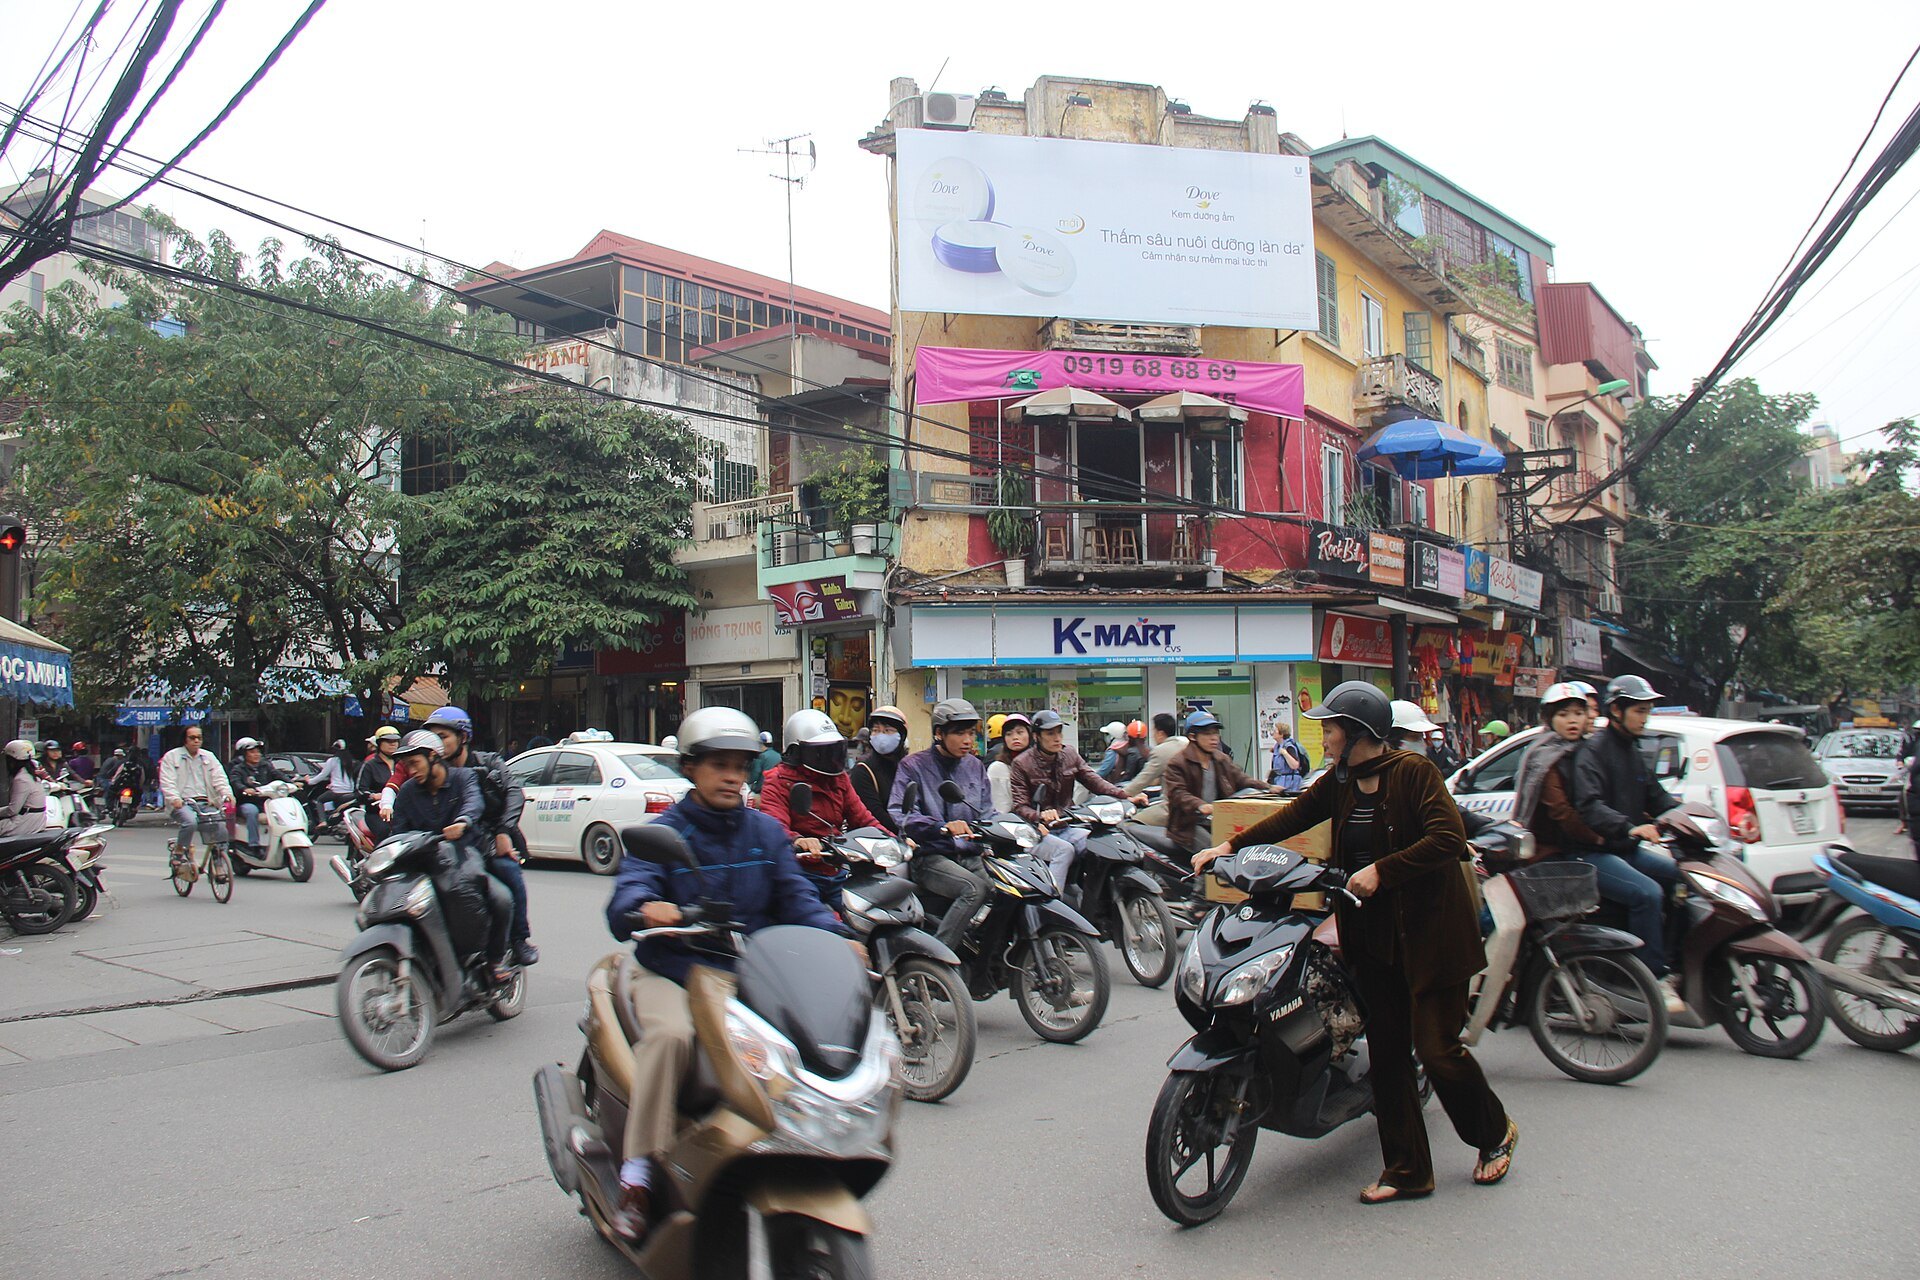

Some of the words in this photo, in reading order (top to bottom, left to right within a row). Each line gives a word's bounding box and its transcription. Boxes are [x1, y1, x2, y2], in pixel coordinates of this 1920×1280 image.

[932, 180, 960, 195] Dove
[1185, 185, 1221, 200] Dove
[1171, 209, 1191, 219] Kem
[1022, 239, 1055, 257] Dove
[1101, 227, 1142, 245] Thấm
[1146, 232, 1172, 247] sâu
[1177, 234, 1207, 249] nuôi
[1211, 236, 1254, 255] dưỡng
[1259, 239, 1279, 254] làn
[1142, 250, 1163, 261] Cảm
[1063, 355, 1125, 376] 0919
[1132, 358, 1162, 378] 68
[1170, 360, 1200, 380] 68
[1207, 363, 1237, 382] 69
[723, 620, 762, 639] TRUNG
[1053, 617, 1176, 655] K-MART
[1164, 645, 1182, 653] CVS
[26, 660, 68, 688] MINH
[137, 711, 160, 720] SINH
[536, 800, 549, 810] TAXI
[1270, 995, 1303, 1022] YAMAHA
